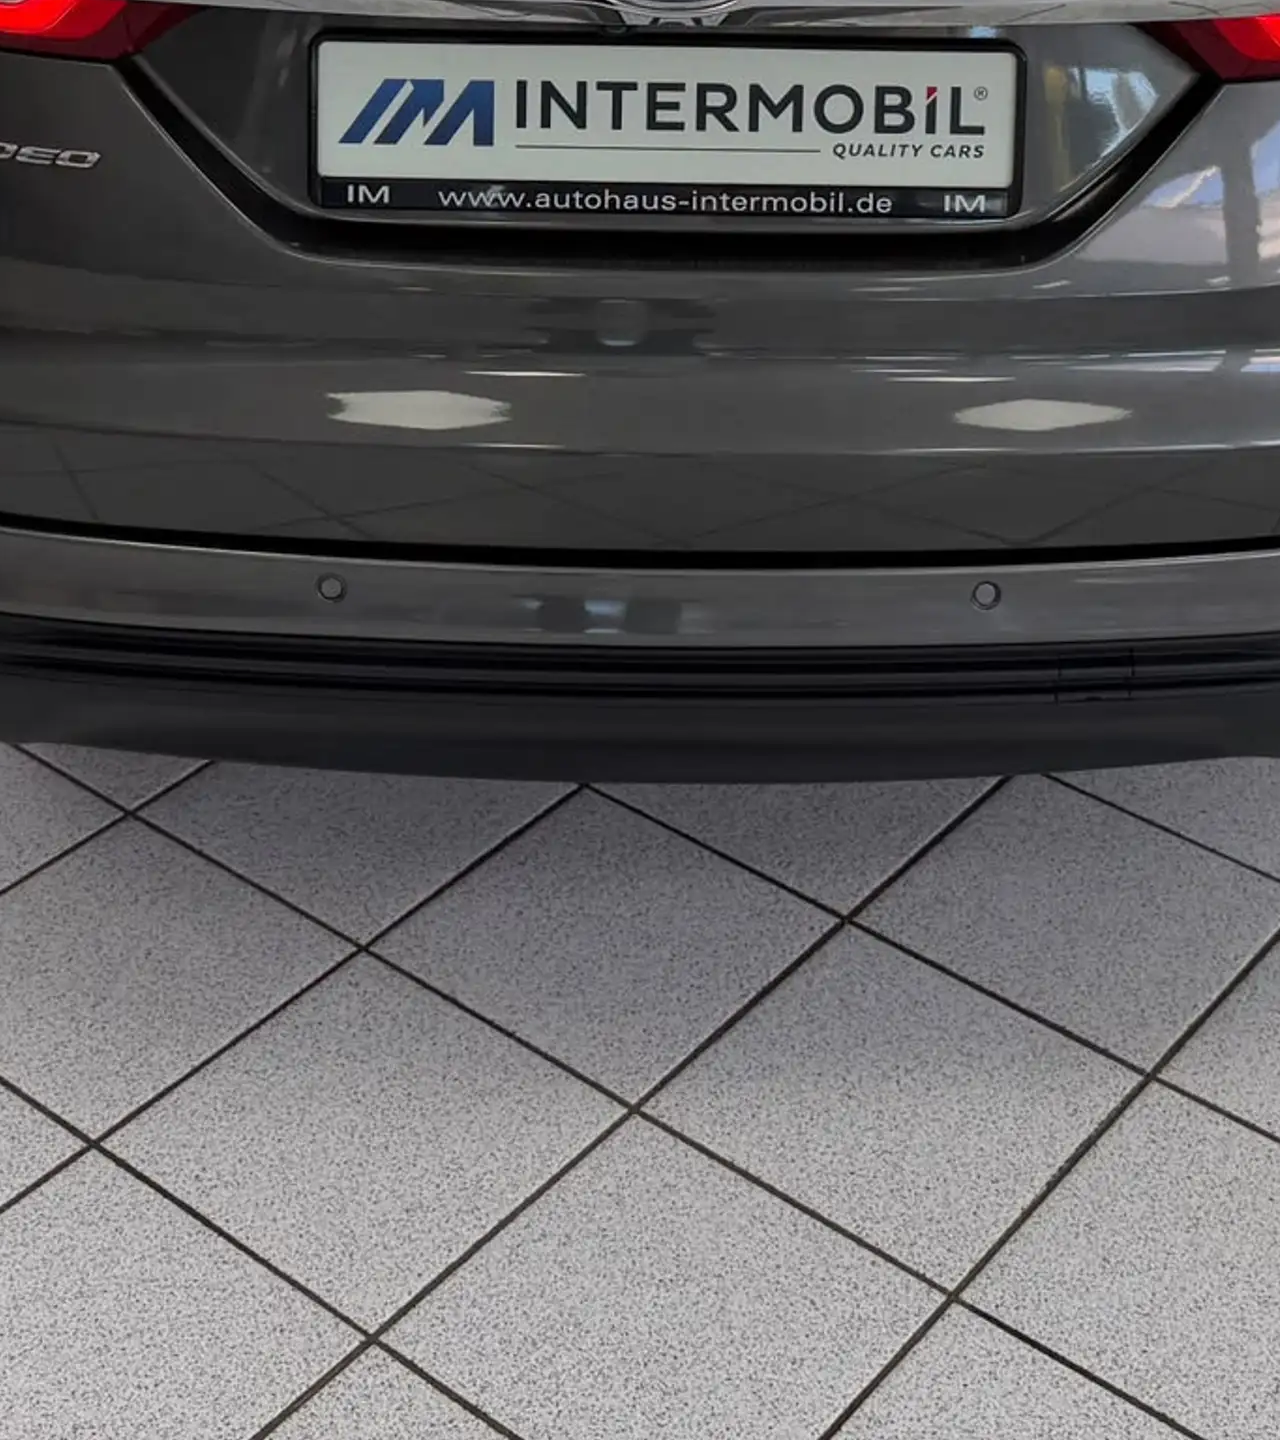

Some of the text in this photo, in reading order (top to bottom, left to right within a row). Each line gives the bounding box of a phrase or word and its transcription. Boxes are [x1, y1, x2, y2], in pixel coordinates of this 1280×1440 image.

[831, 142, 986, 161] QUALITY CARS
[346, 183, 986, 214] IM www.autohaus-intermobil.de IM
